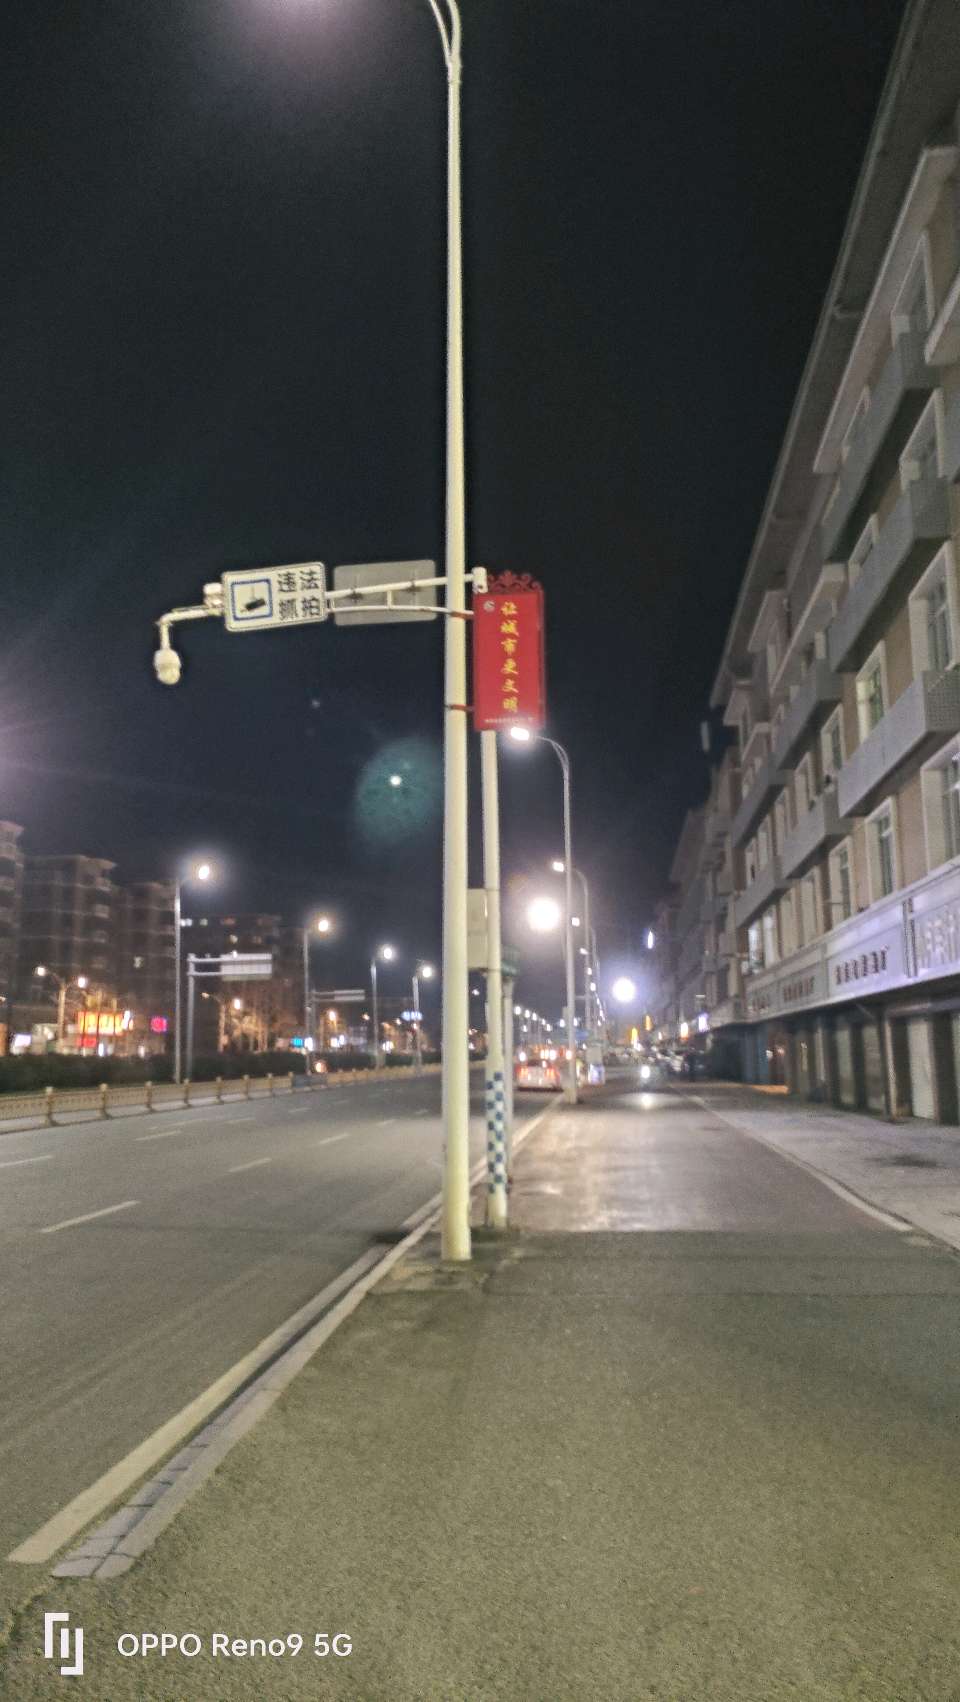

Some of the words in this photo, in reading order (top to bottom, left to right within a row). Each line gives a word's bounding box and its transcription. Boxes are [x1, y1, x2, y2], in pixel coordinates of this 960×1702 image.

[277, 569, 320, 592] 违法
[500, 601, 519, 713] 让城市更文明
